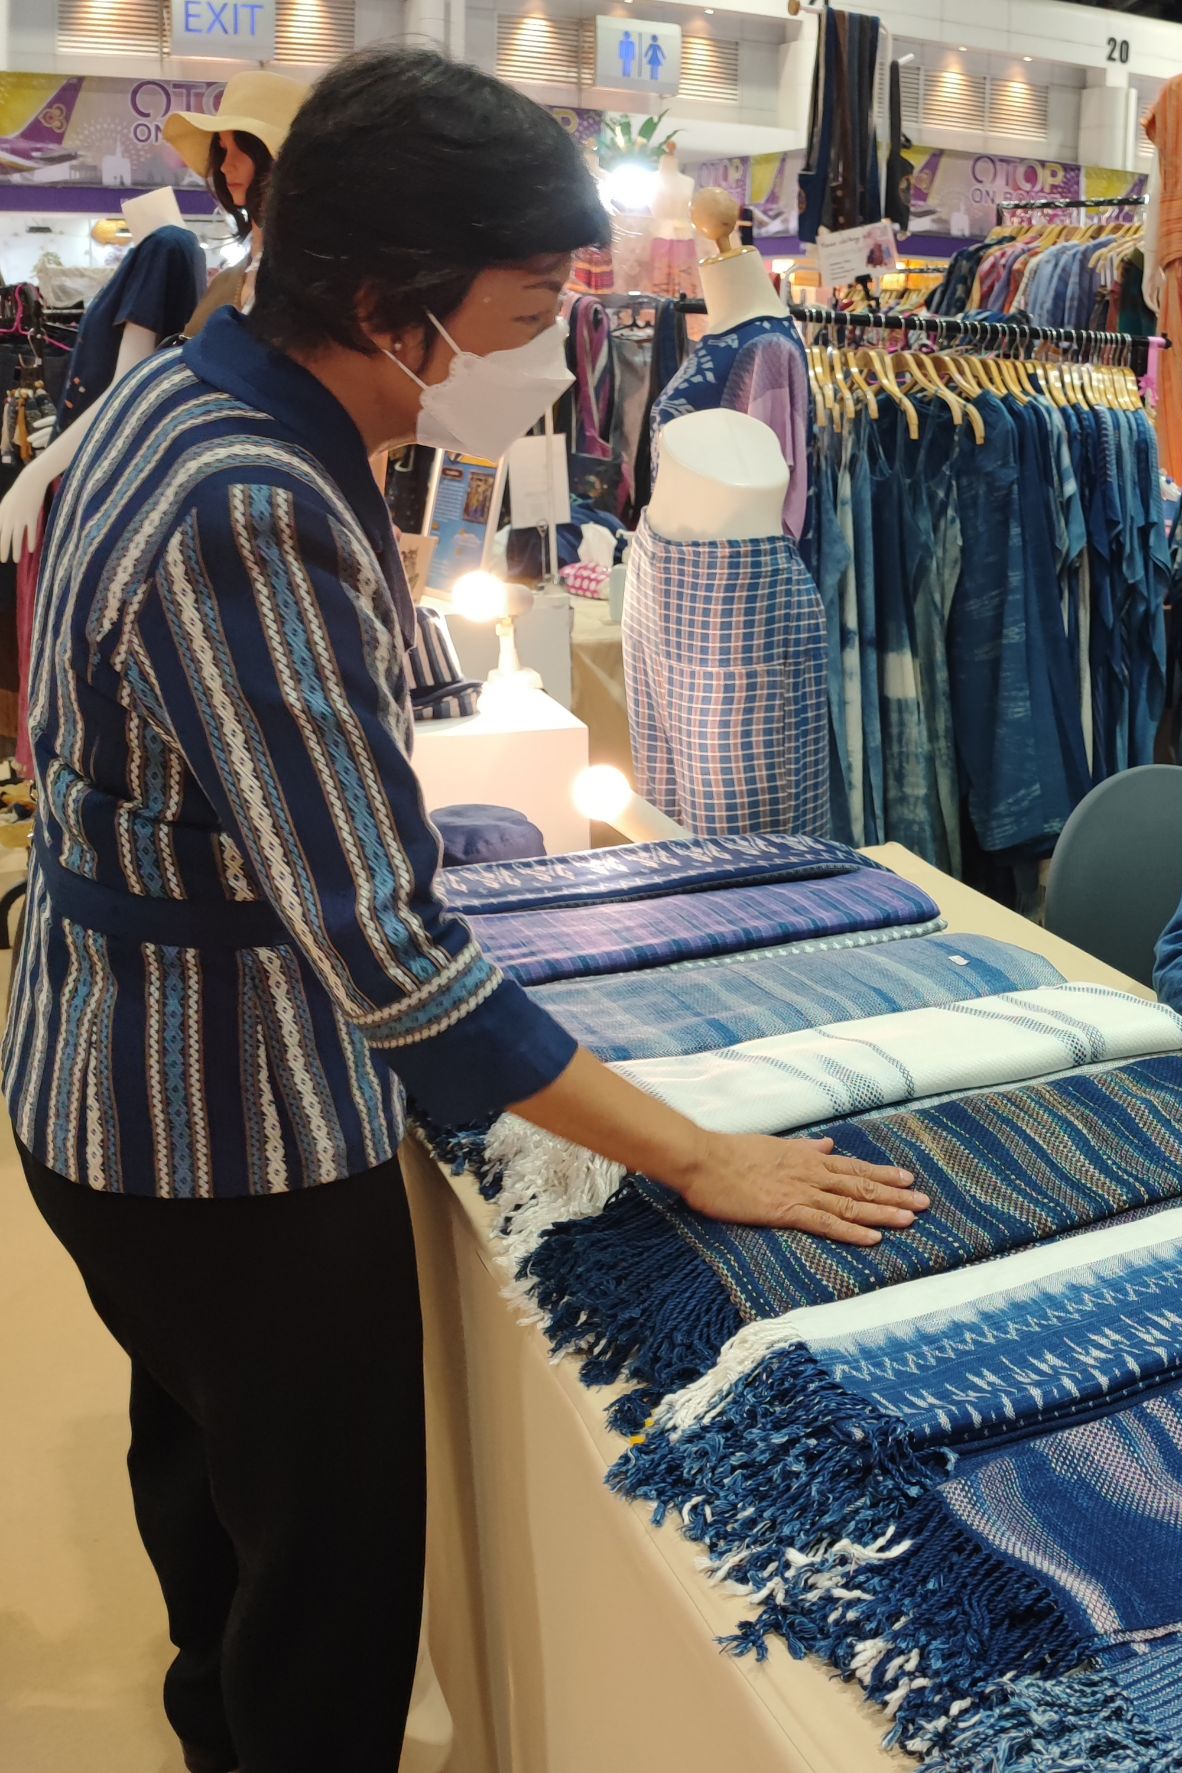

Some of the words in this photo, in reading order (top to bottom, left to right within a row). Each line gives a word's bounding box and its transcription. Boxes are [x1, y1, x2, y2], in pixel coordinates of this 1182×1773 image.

[184, 0, 264, 36] EXIT
[1107, 37, 1129, 63] 20
[972, 155, 1065, 193] OTOP
